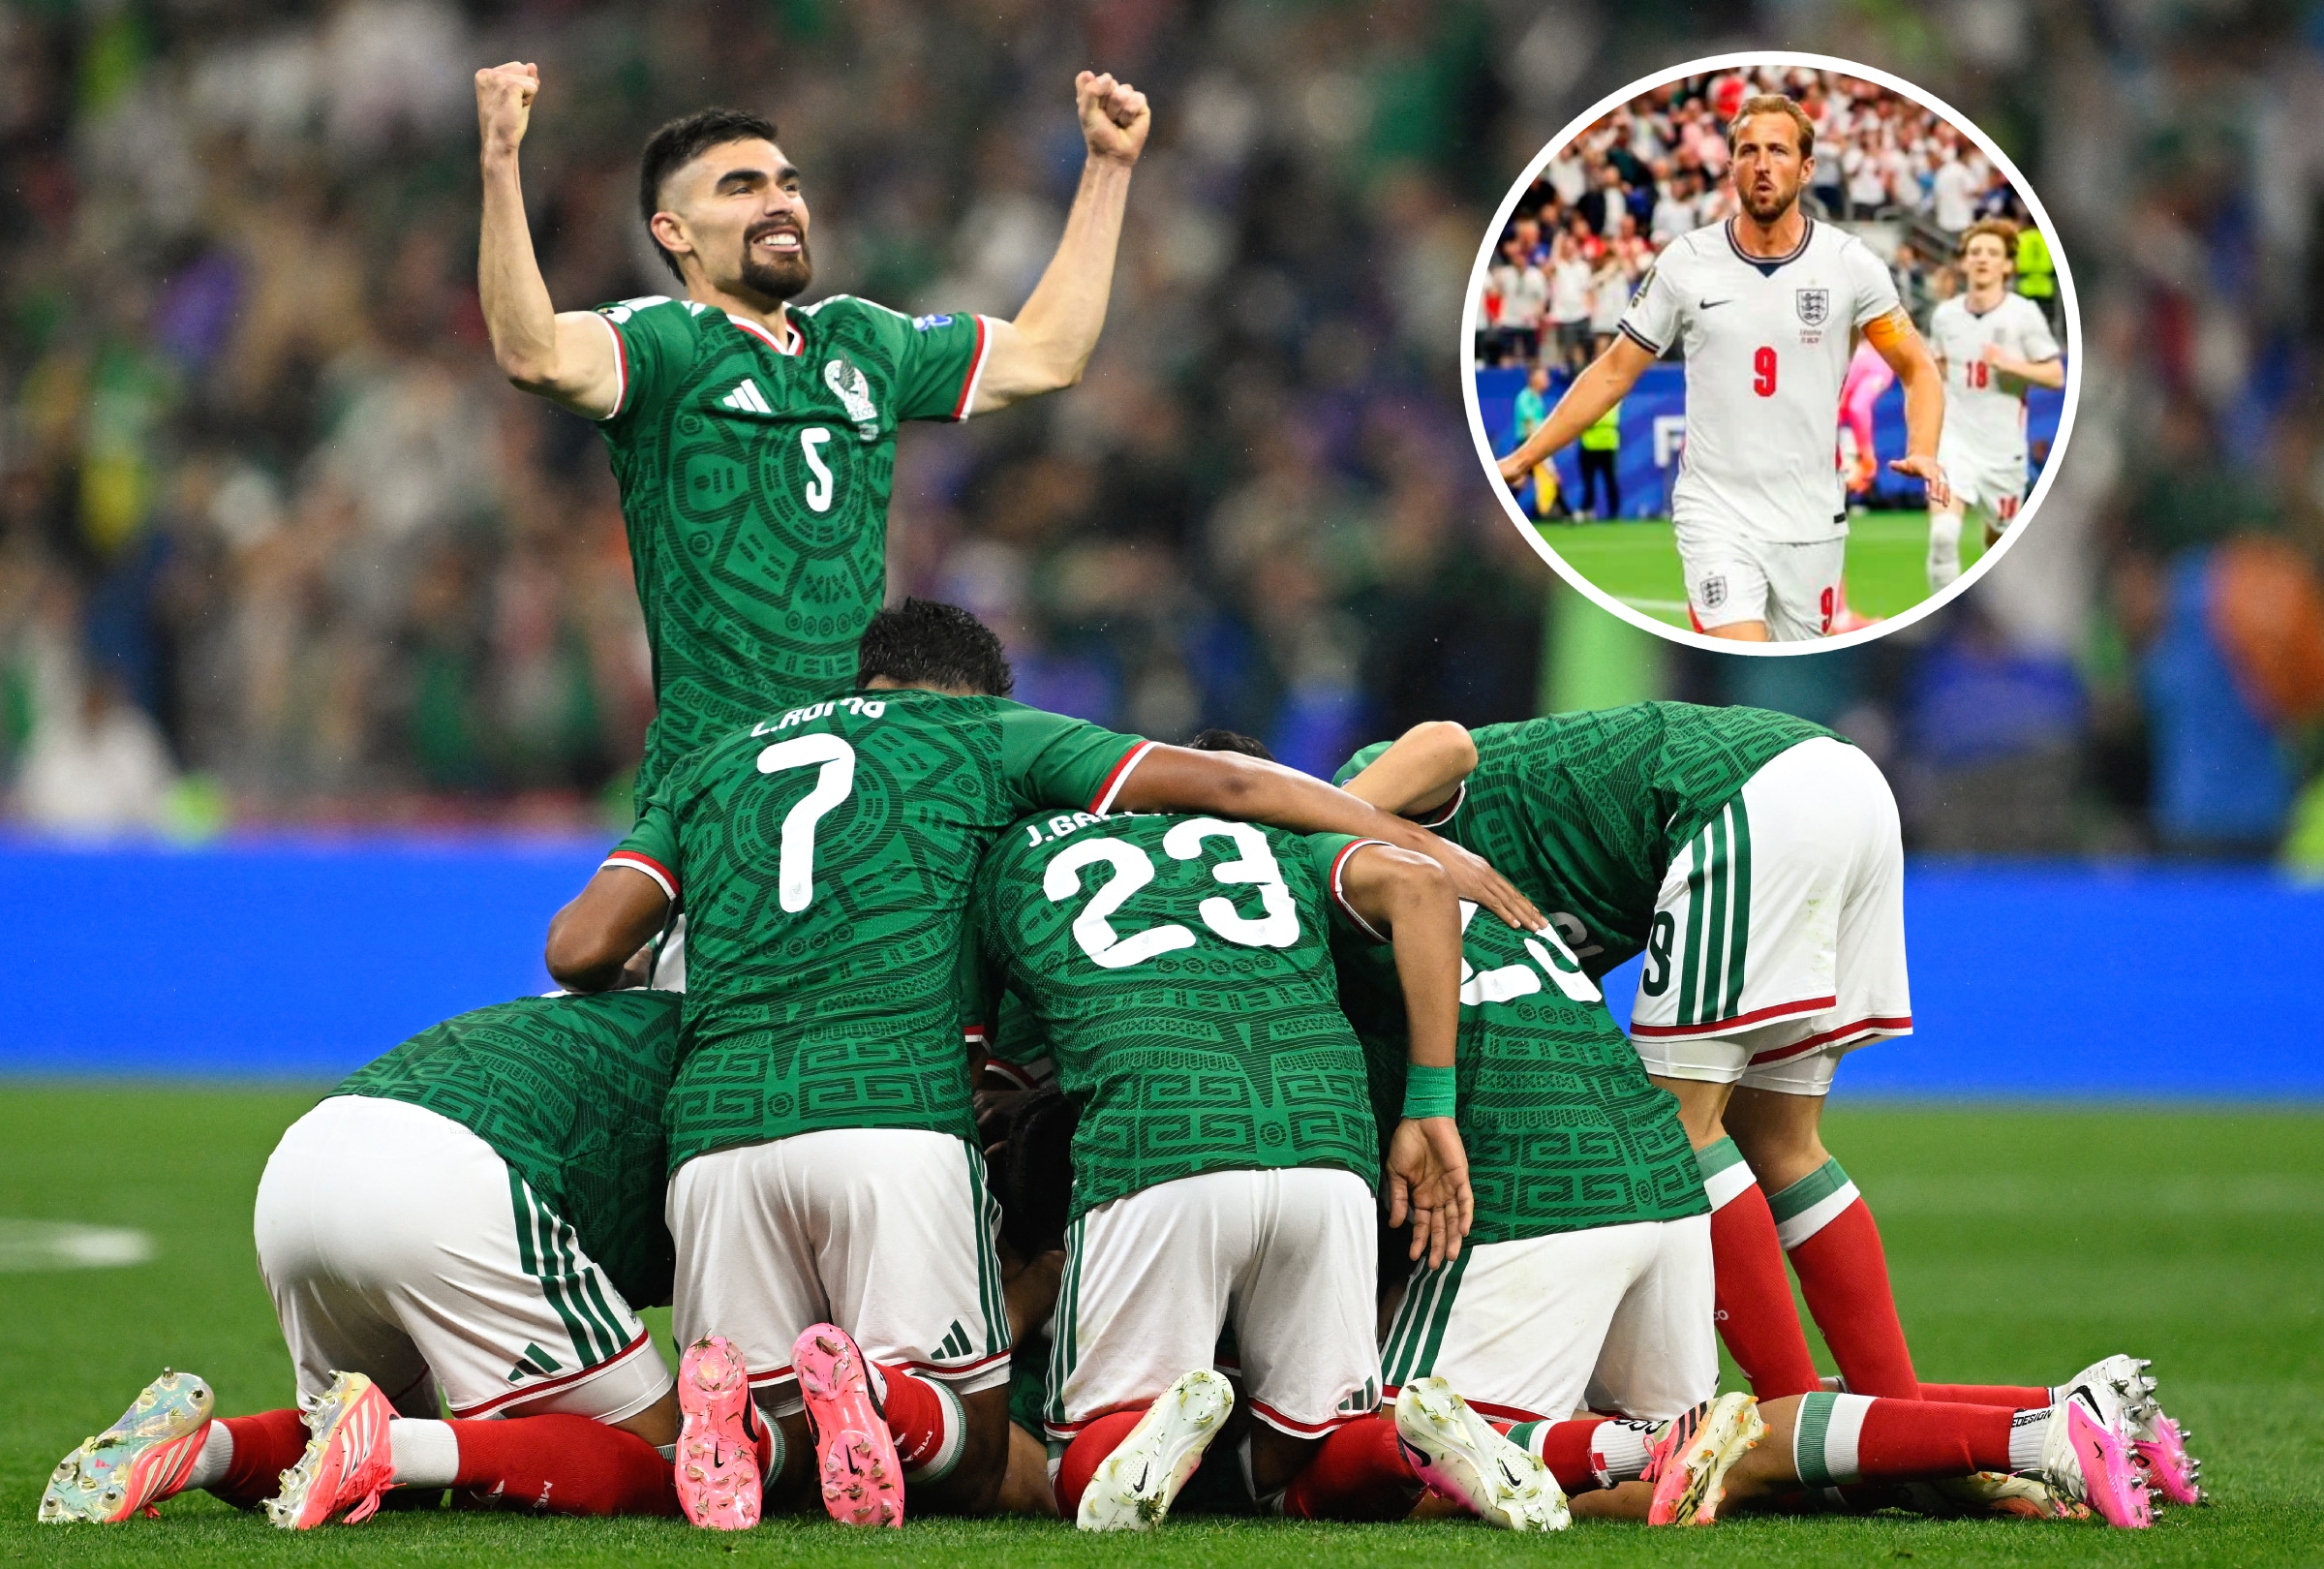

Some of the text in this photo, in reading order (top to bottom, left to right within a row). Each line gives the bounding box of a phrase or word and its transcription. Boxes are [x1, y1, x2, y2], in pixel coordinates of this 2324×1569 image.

[1754, 346, 1778, 398] 9
[1966, 361, 1988, 388] 18
[800, 427, 833, 512] 5
[1820, 586, 1833, 634] 9
[756, 732, 856, 913] 7
[1043, 816, 1300, 969] 23
